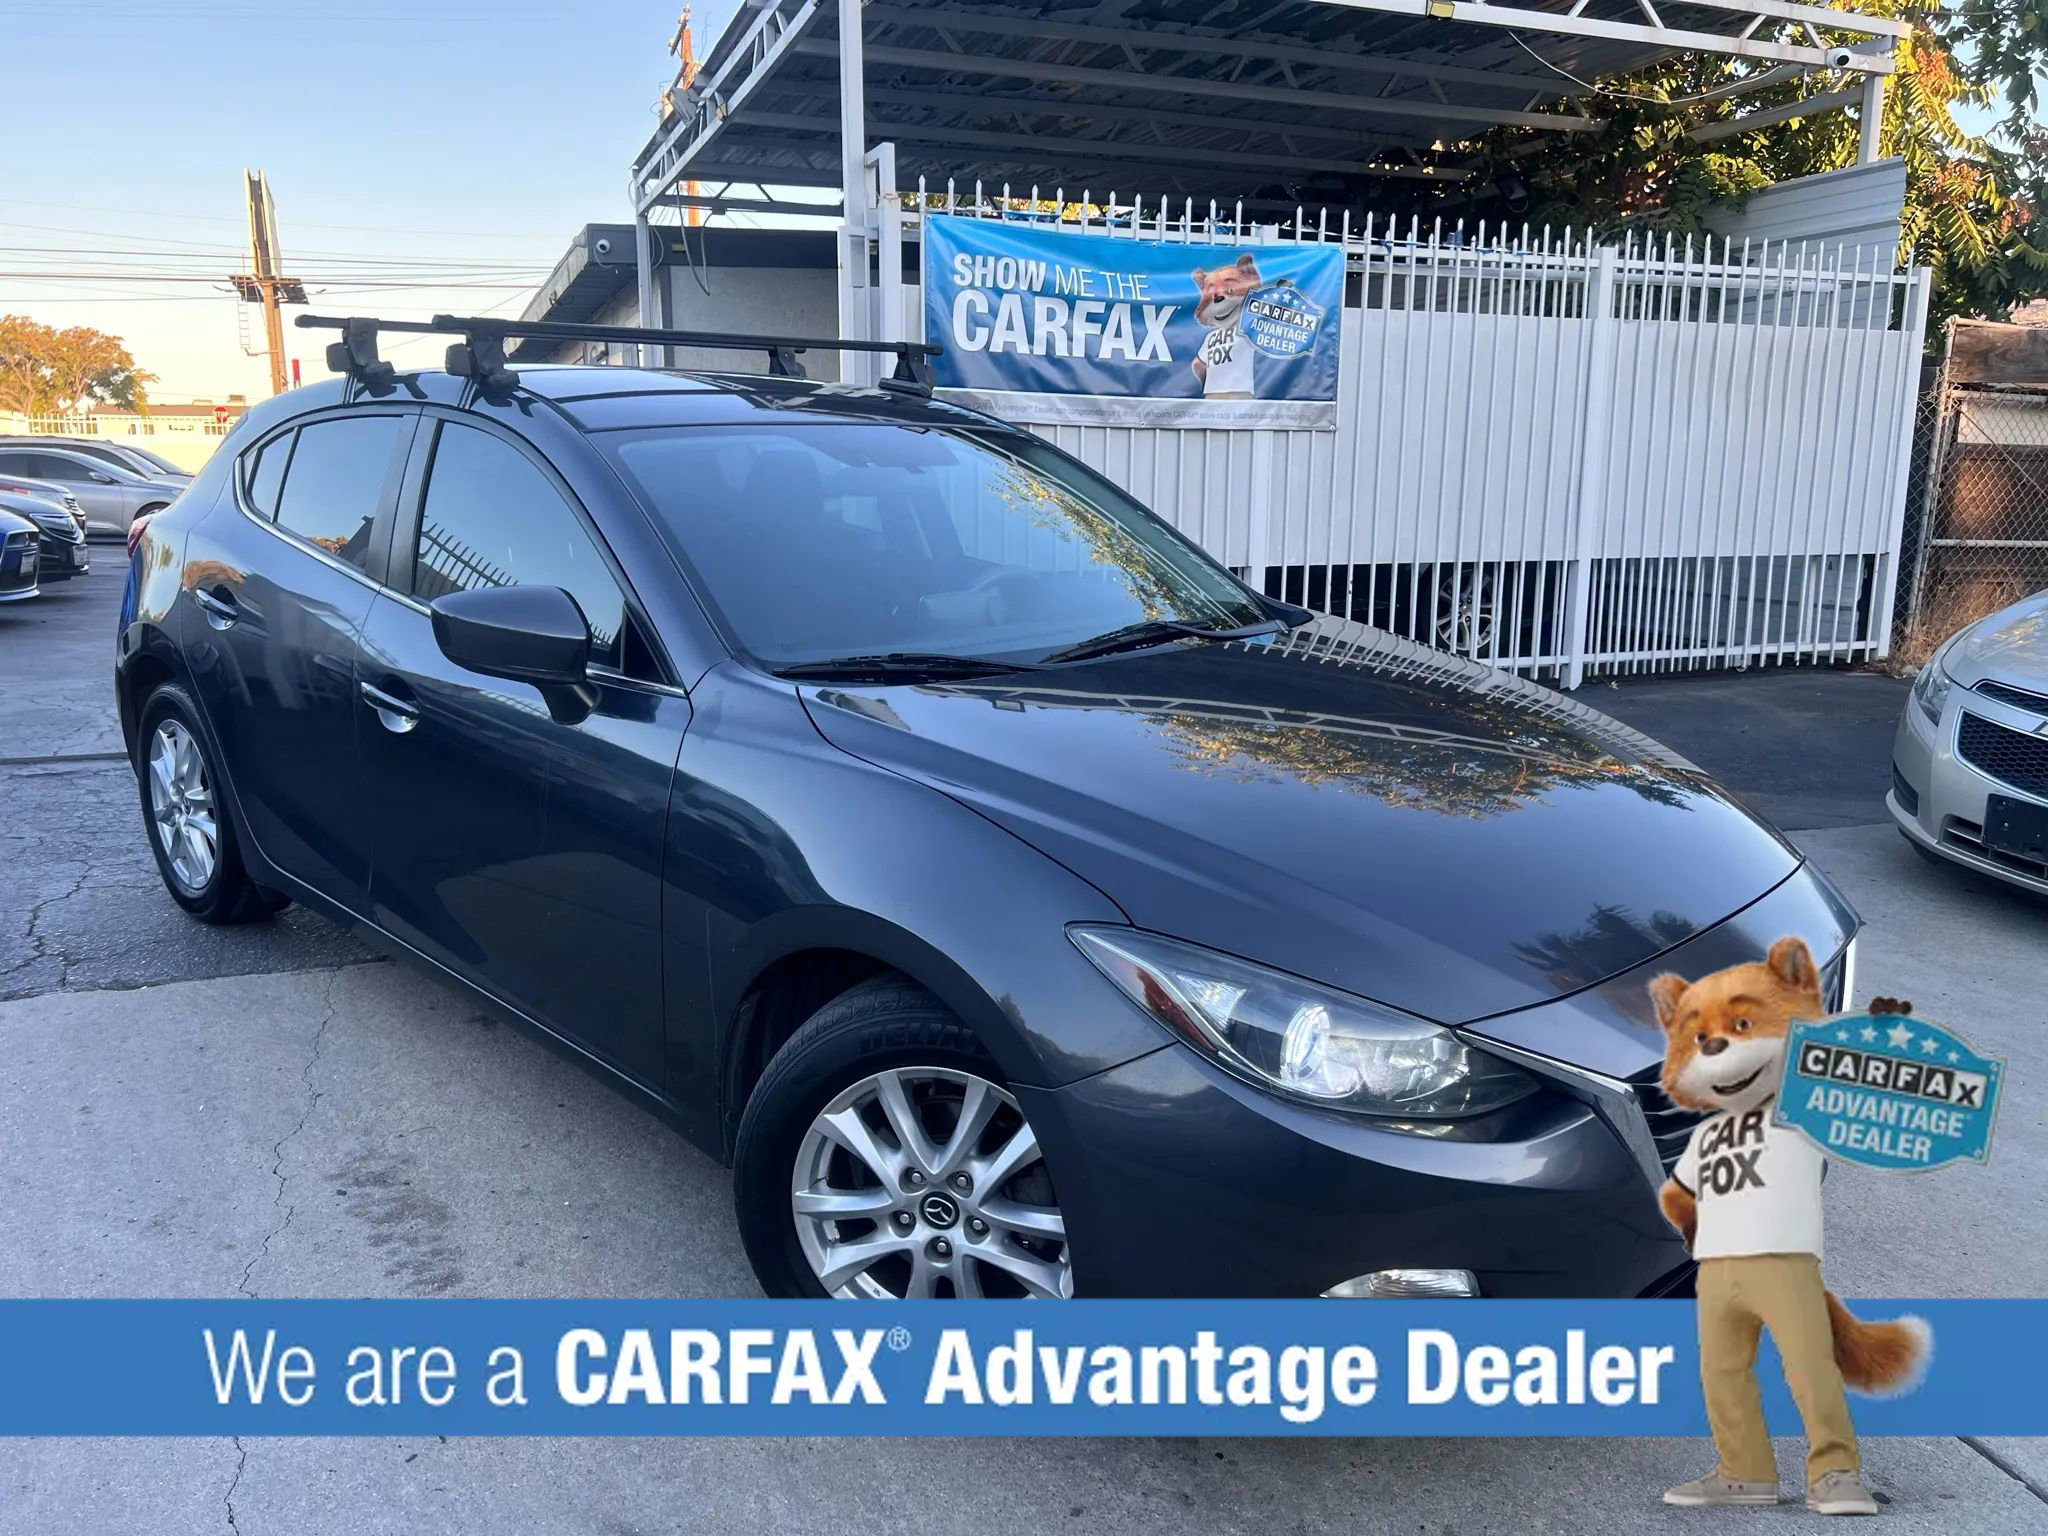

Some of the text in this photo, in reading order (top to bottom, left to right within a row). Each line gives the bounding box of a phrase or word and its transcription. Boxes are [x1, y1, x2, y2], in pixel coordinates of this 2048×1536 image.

[953, 252, 1151, 301] SHOW ME THE
[953, 289, 1174, 362] CARFAX
[1248, 299, 1315, 330] CARFAX
[1207, 328, 1235, 349] CAR
[1250, 318, 1309, 343] ADVANTAGE
[1256, 333, 1297, 353] DEALER
[1206, 345, 1233, 368] FOX
